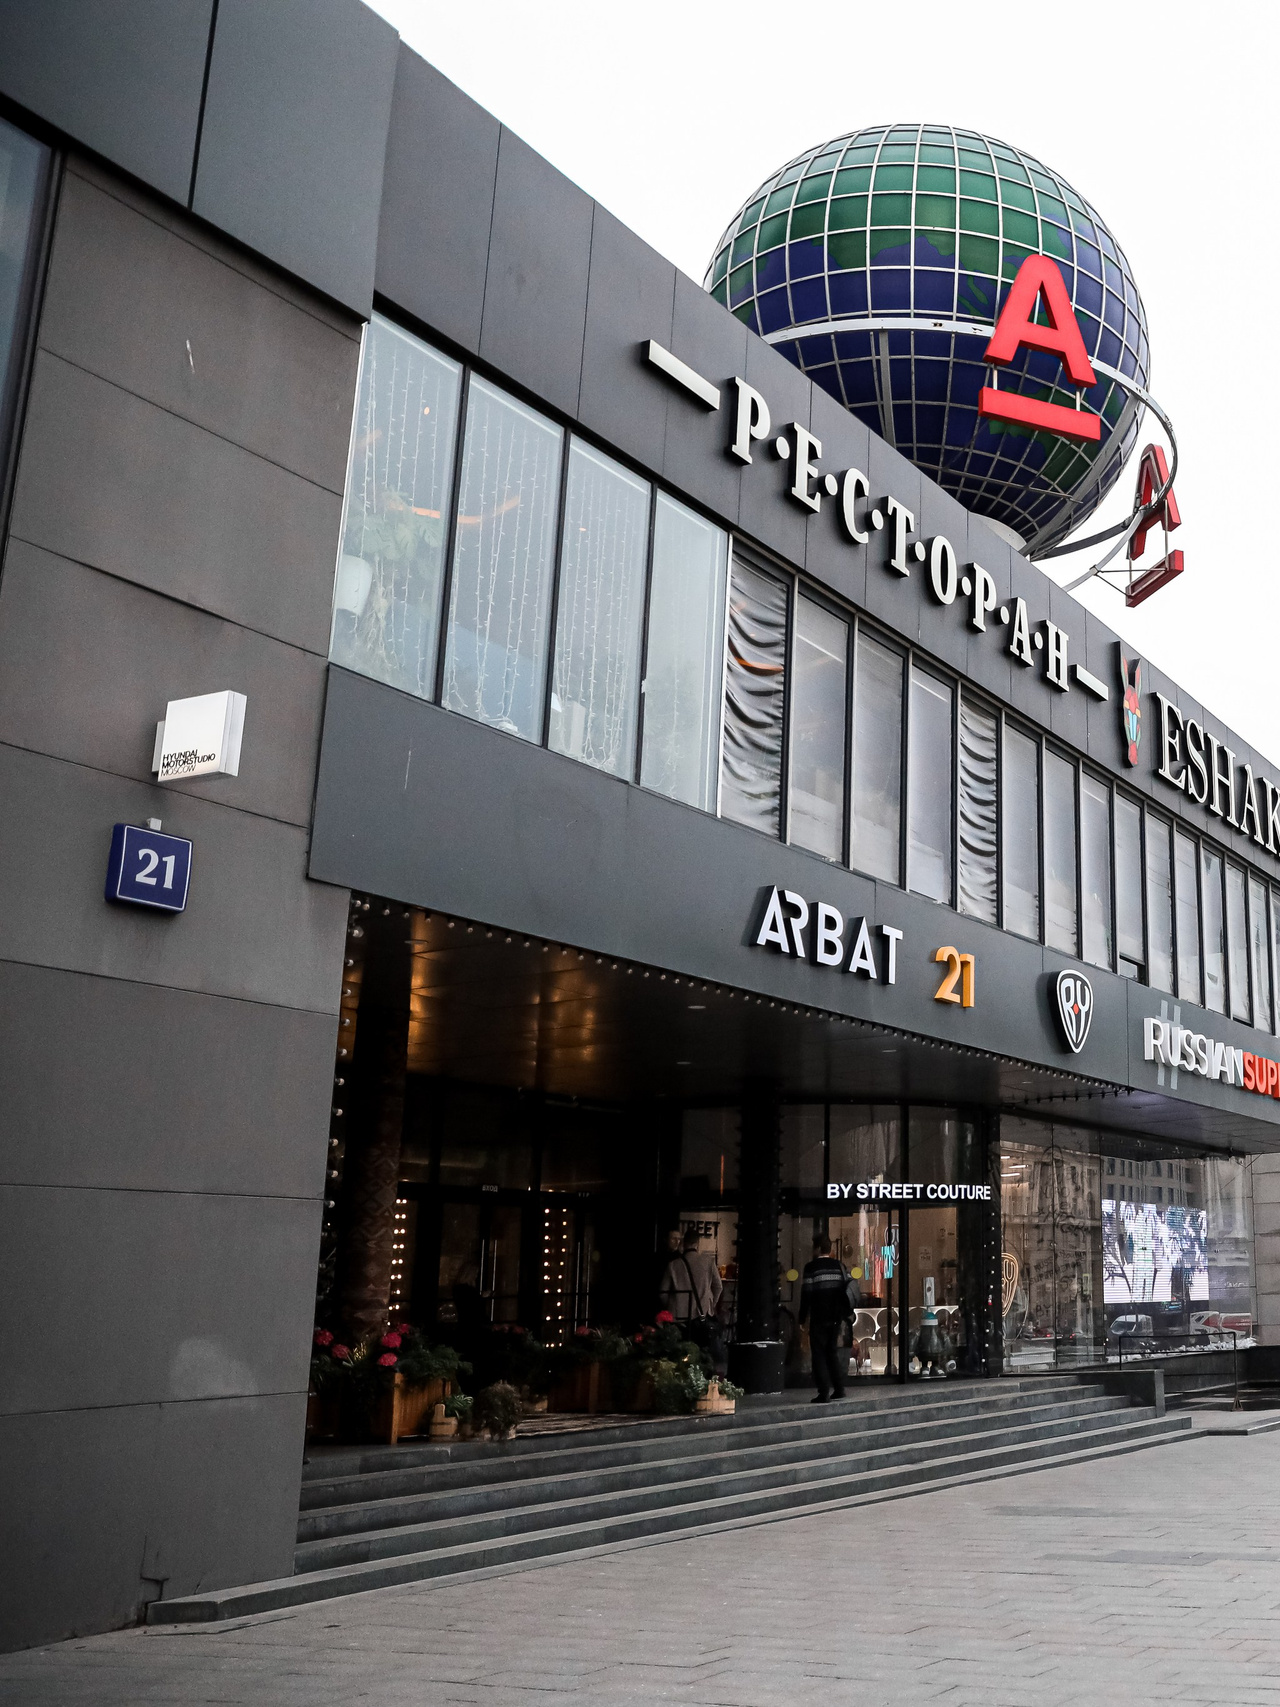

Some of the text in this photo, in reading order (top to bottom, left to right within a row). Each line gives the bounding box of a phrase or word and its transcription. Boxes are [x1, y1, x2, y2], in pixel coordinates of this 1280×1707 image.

[162, 753, 216, 768] MOTORSTUDIO
[163, 749, 198, 760] HYUNDAI
[160, 764, 196, 777] MOSCOW
[135, 848, 176, 889] 21
[755, 884, 975, 1008] ARBAT 21
[826, 1183, 991, 1200] BY STREET COUTURE
